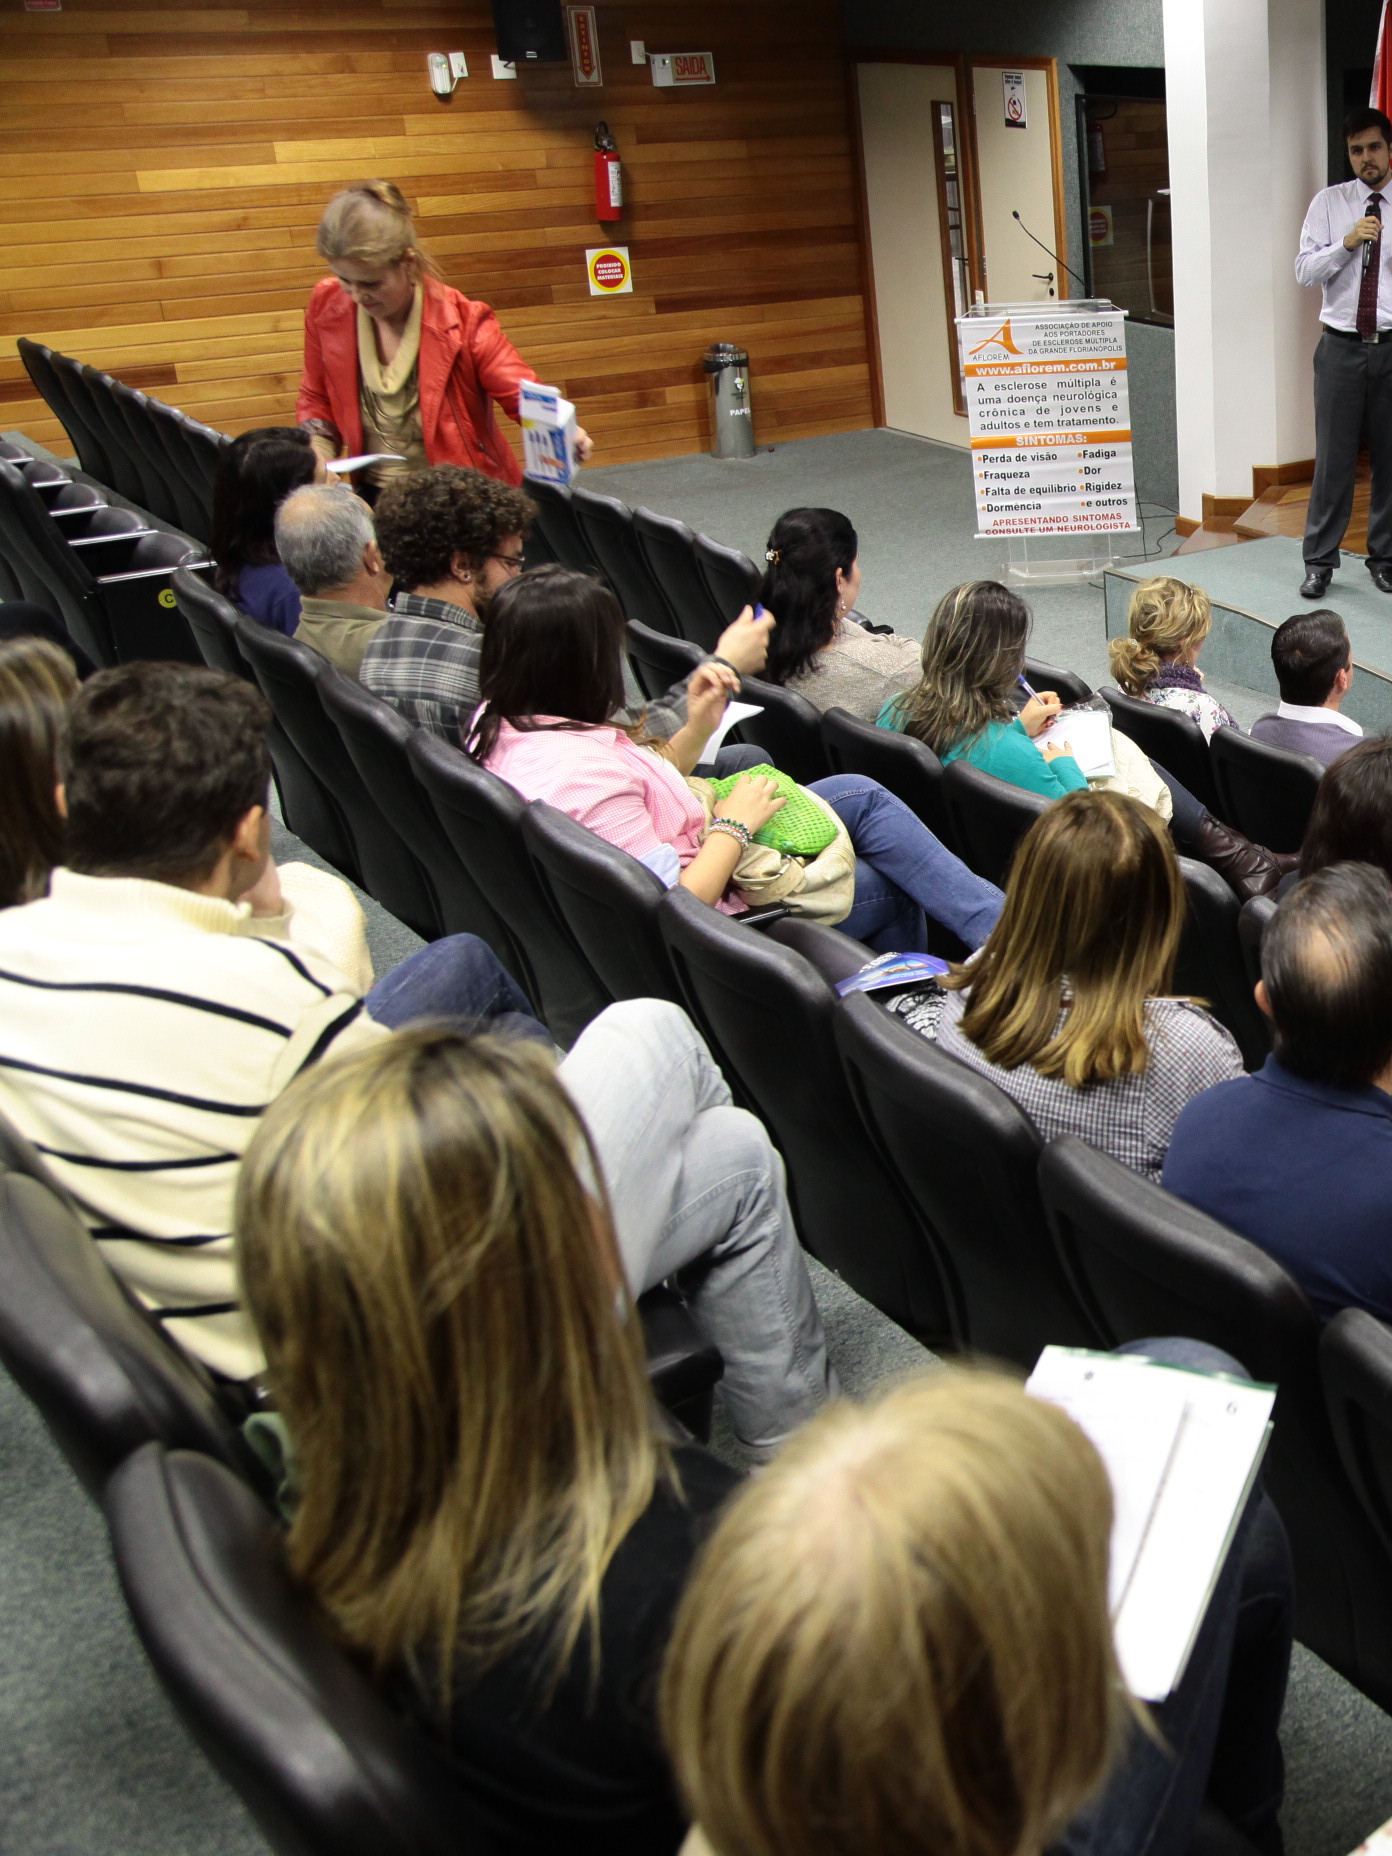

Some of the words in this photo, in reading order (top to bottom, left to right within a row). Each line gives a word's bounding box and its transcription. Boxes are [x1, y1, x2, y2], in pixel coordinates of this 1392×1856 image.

[1035, 322, 1079, 331] ASSOCIAÇÃO
[1092, 321, 1113, 329] APOIO
[1044, 330, 1058, 338] AOS
[1060, 329, 1105, 337] PORTADORES
[1043, 338, 1084, 346] ESCLEROSE
[1085, 336, 1118, 344] MÚLTIPLA
[1028, 348, 1038, 356] DA
[1039, 347, 1068, 355] GRANDE
[1069, 344, 1123, 353] FLORIANÓPOLIS
[973, 353, 1010, 361] AFLOREM
[976, 360, 1116, 376] www.aflorem.com.br
[977, 383, 985, 392] A
[994, 380, 1048, 391] esclerose
[1057, 377, 1101, 389] múltipla
[1110, 376, 1117, 386] é
[978, 396, 1001, 405] uma
[1007, 393, 1048, 404] doença
[1052, 390, 1118, 402] neurológica
[730, 407, 751, 416] PAPEL
[979, 408, 1026, 418] crônica
[1035, 405, 1051, 415] de
[1060, 403, 1102, 416] jovens
[1111, 404, 1119, 412] e
[980, 420, 1021, 431] adultos
[1024, 421, 1031, 429] e
[1034, 418, 1054, 428] tem
[1057, 415, 1119, 427] tratamento.
[1016, 433, 1088, 447] SINTOMAS:
[982, 454, 1012, 464] Perda
[1015, 453, 1028, 462] de
[1031, 452, 1058, 461] visão
[1082, 450, 1117, 460] Fadiga
[983, 469, 1031, 481] Fraqueza
[1084, 466, 1102, 475] Dor
[985, 487, 1011, 497] Falta
[1014, 486, 1027, 495] de
[1029, 483, 1077, 496] equilíbrio
[1085, 481, 1123, 493] Rigidez
[986, 501, 1042, 513] Dormência
[1086, 500, 1093, 508] e
[1095, 498, 1128, 507] outros
[992, 515, 1070, 527] APRESENTANDO
[1072, 512, 1123, 523] SINTOMAS
[985, 528, 1037, 536] CONSULTE
[1057, 522, 1131, 532] NEUROLOGISTA
